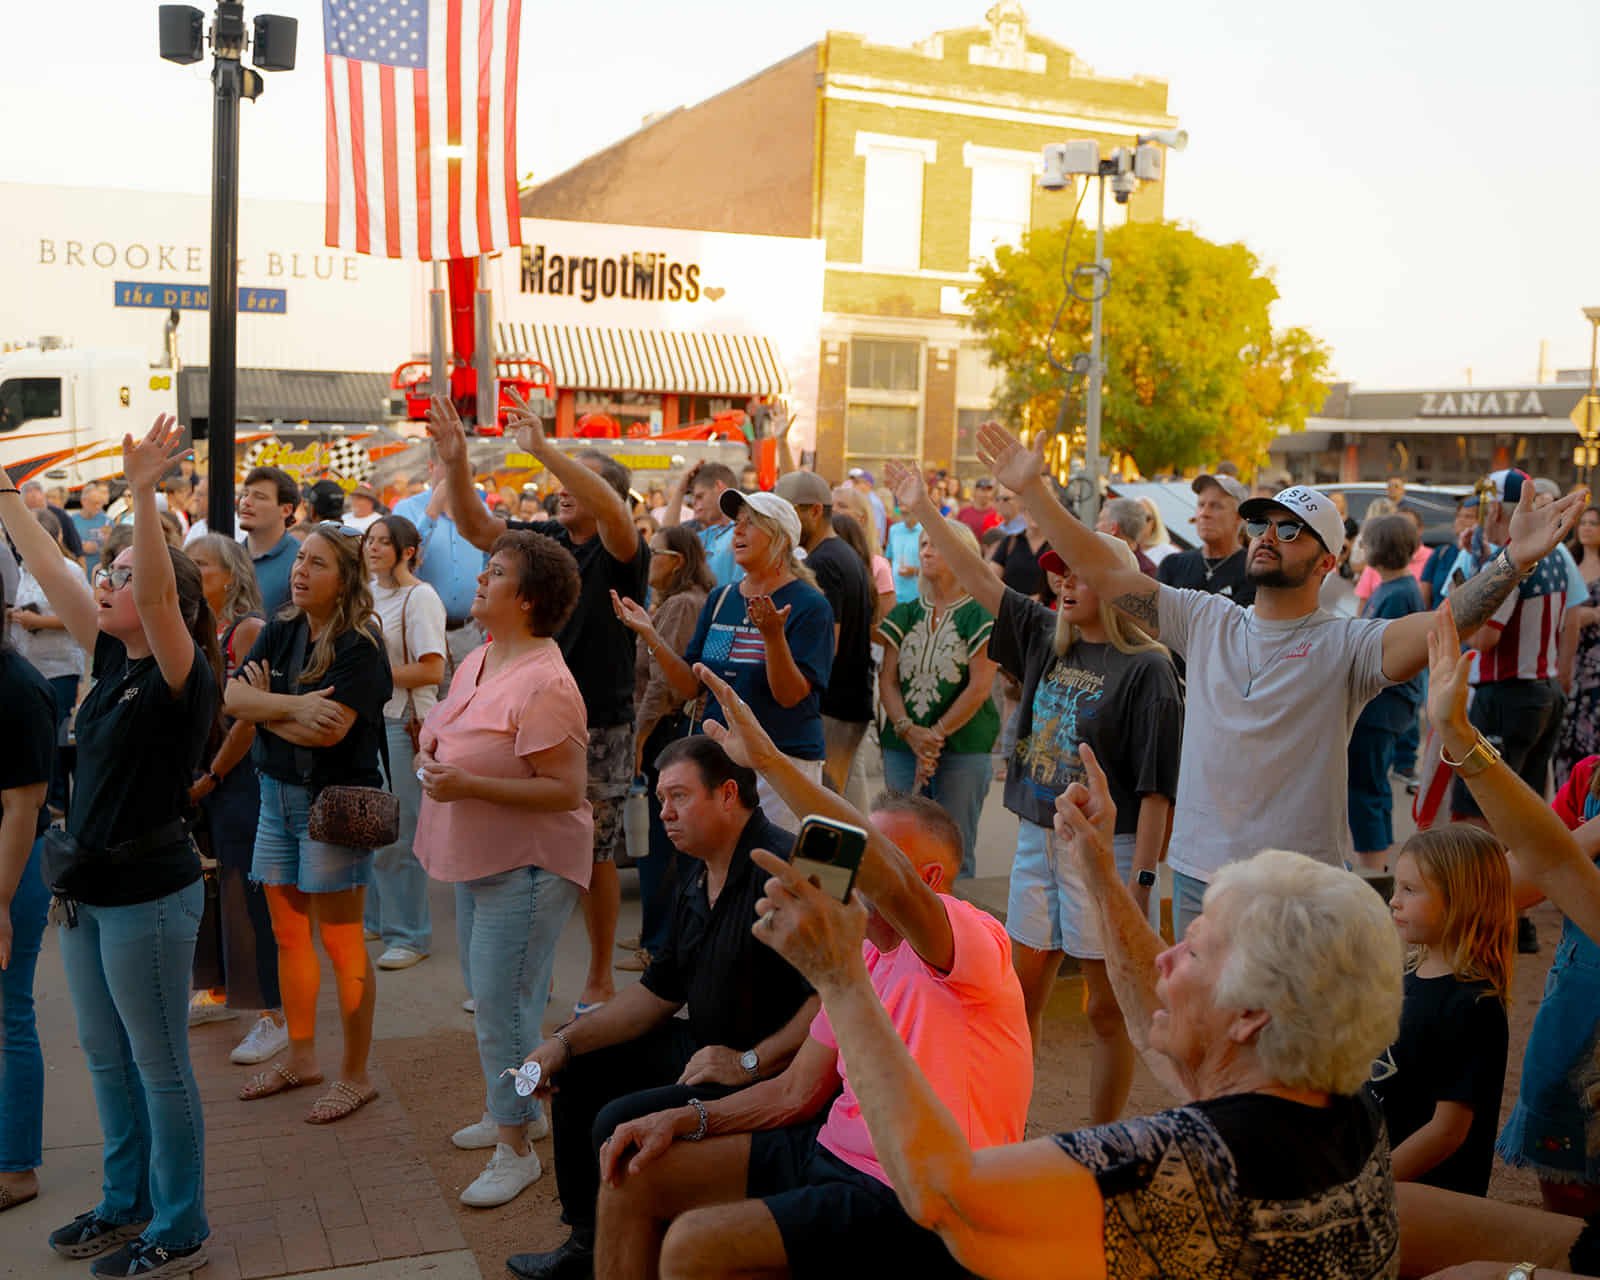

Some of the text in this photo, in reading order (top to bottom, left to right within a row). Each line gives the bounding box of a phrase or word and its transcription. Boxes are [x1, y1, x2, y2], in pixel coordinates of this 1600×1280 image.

[39, 240, 201, 272] BROOKE
[266, 252, 359, 281] BLUE
[520, 245, 700, 302] MargotMiss
[123, 284, 154, 305] the
[246, 289, 280, 310] bar
[1421, 391, 1543, 415] ZANATA
